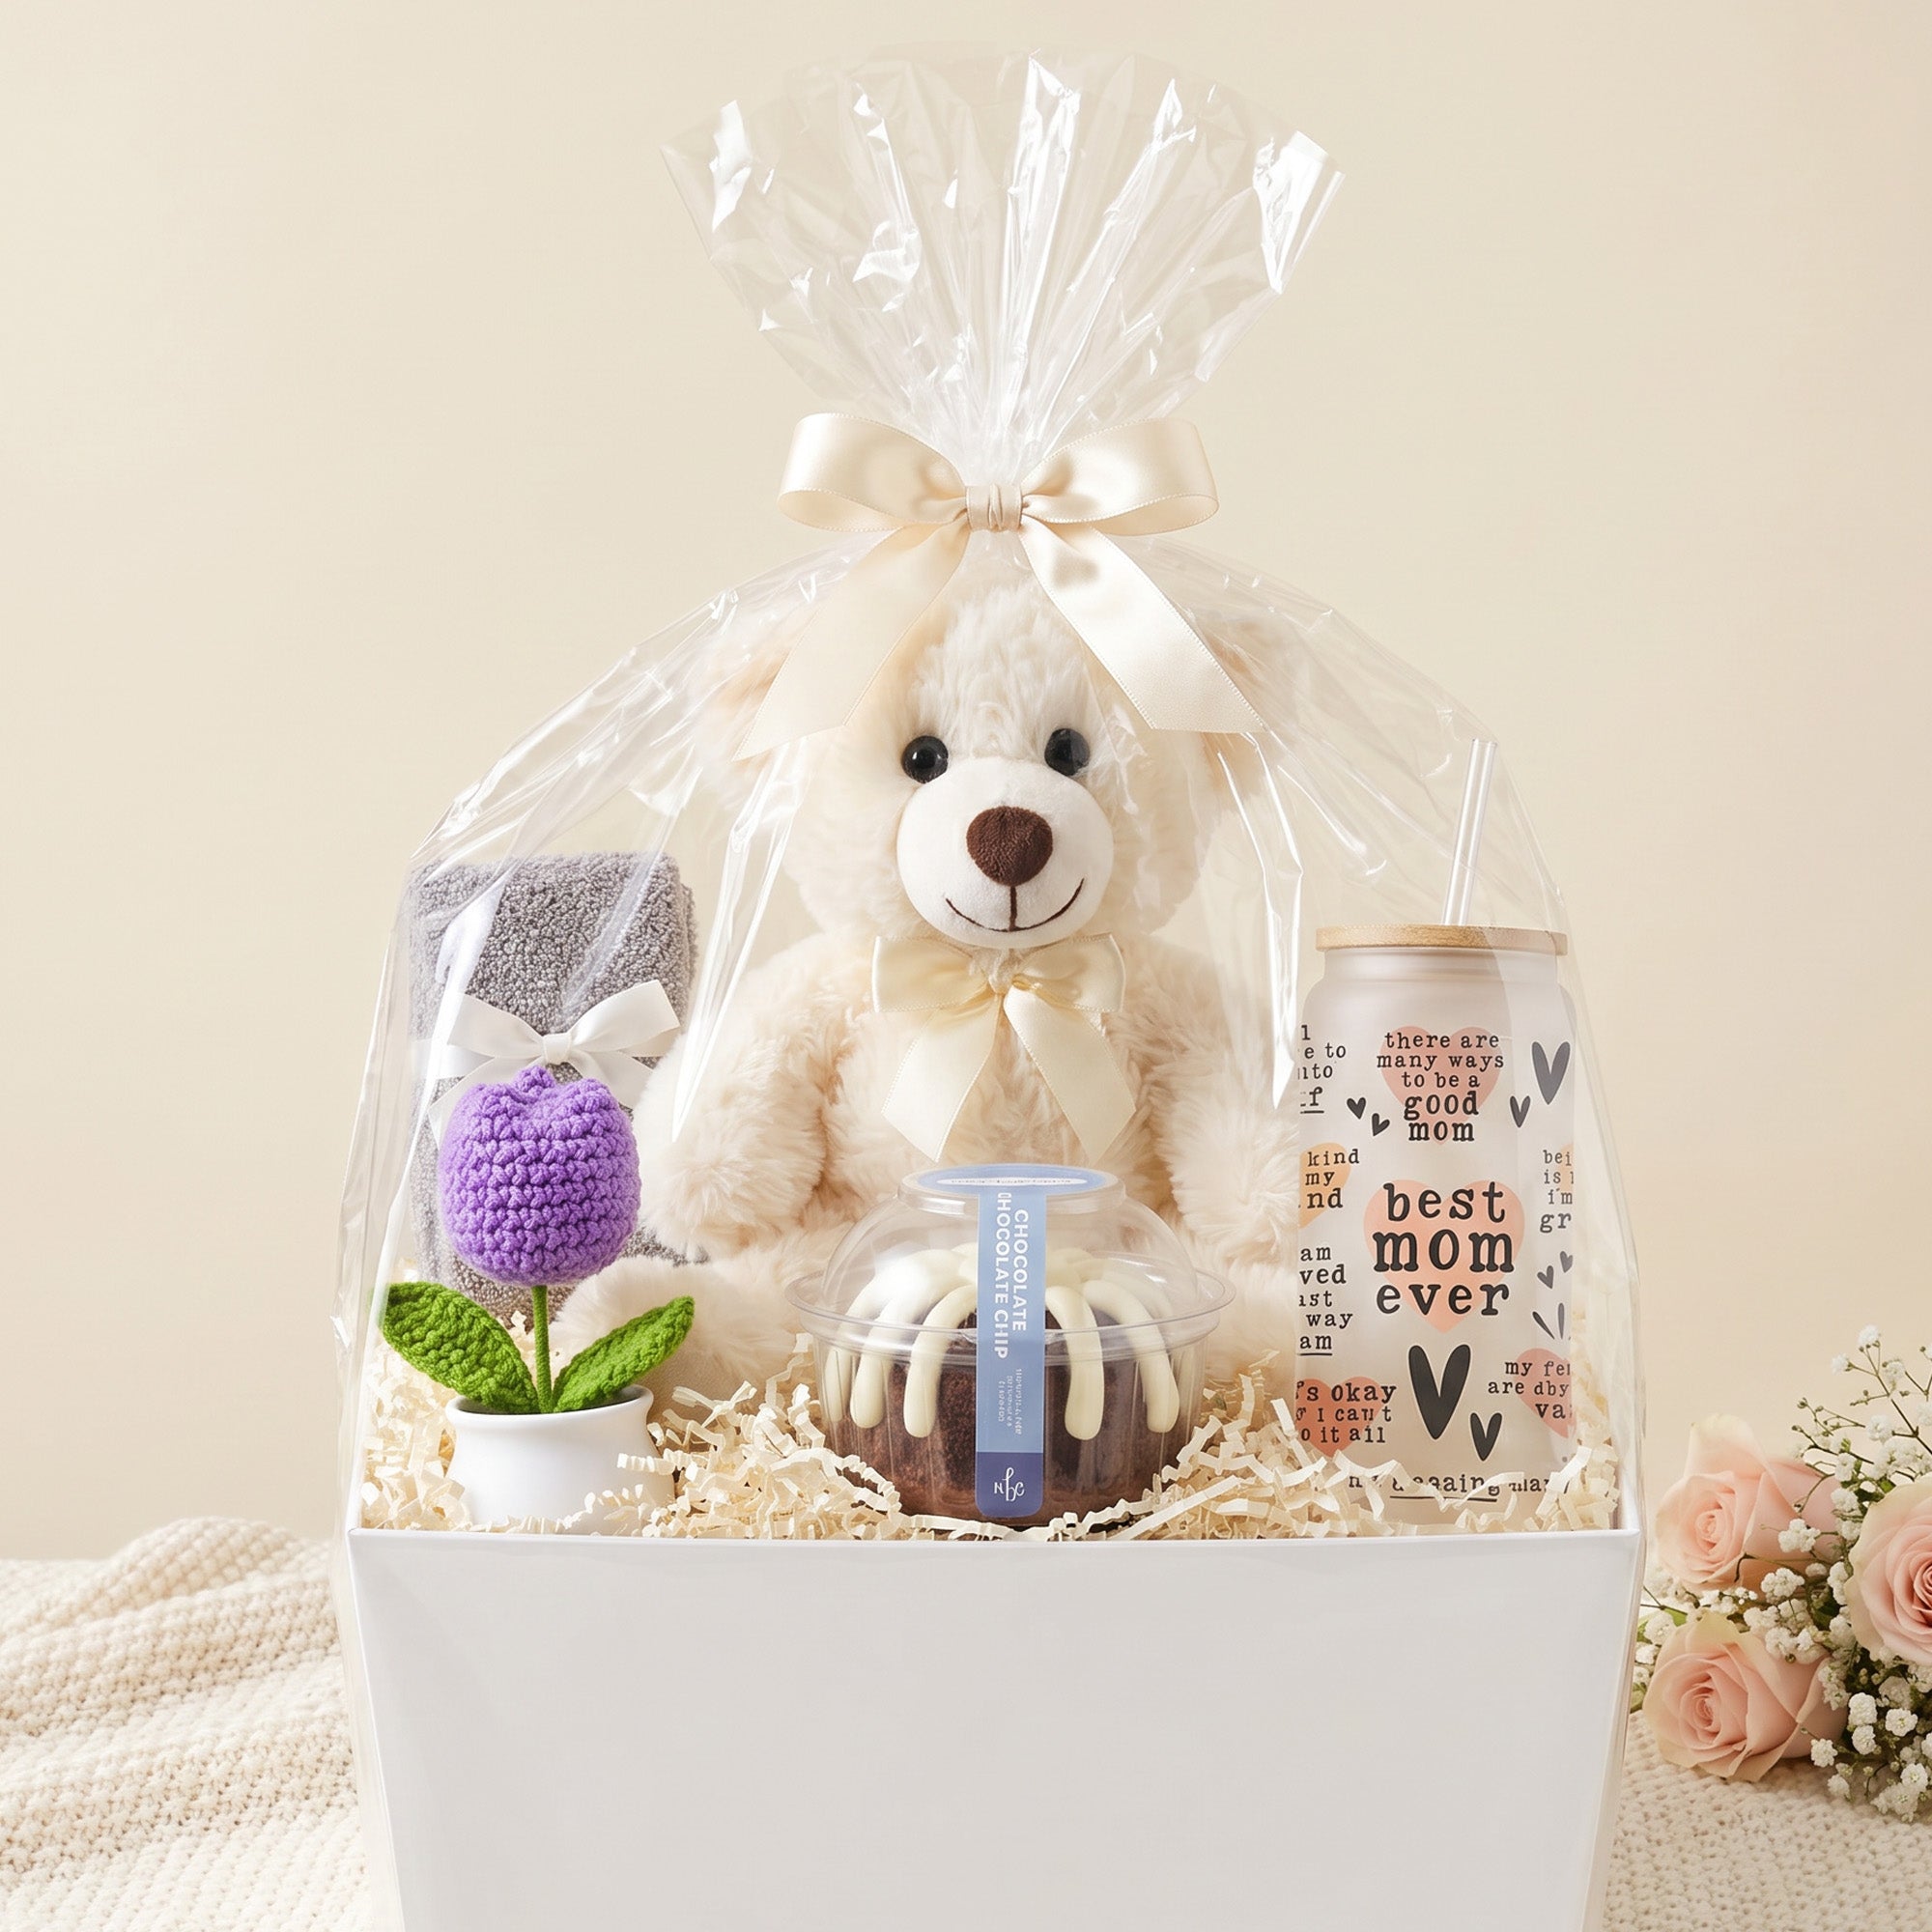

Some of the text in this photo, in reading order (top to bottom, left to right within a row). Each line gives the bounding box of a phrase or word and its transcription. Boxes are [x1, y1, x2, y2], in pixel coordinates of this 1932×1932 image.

[1384, 1033, 1499, 1049] there are
[1324, 1042, 1347, 1059] to
[1377, 1054, 1504, 1072] many ways
[1402, 1072, 1481, 1088] to be a
[1404, 1091, 1479, 1121] good
[1408, 1121, 1475, 1142] mom
[1307, 1149, 1360, 1167] kind
[1305, 1172, 1335, 1186] my
[1544, 1169, 1561, 1184] is
[1307, 1187, 1344, 1209] nd
[1383, 1181, 1505, 1223] best
[1540, 1213, 1572, 1233] gr
[1300, 1247, 1331, 1262] am
[1373, 1229, 1515, 1272] mom
[1012, 1209, 1029, 1331] CHOCOLATE
[1299, 1264, 1347, 1285] ved
[1377, 1283, 1509, 1316] ever
[1306, 1314, 1353, 1329] way
[994, 1309, 1009, 1359] CHIP
[1299, 1335, 1332, 1350] am
[1505, 1361, 1532, 1377] my
[1331, 1382, 1397, 1404] okay
[1488, 1381, 1524, 1394] are
[1321, 1427, 1340, 1443] it
